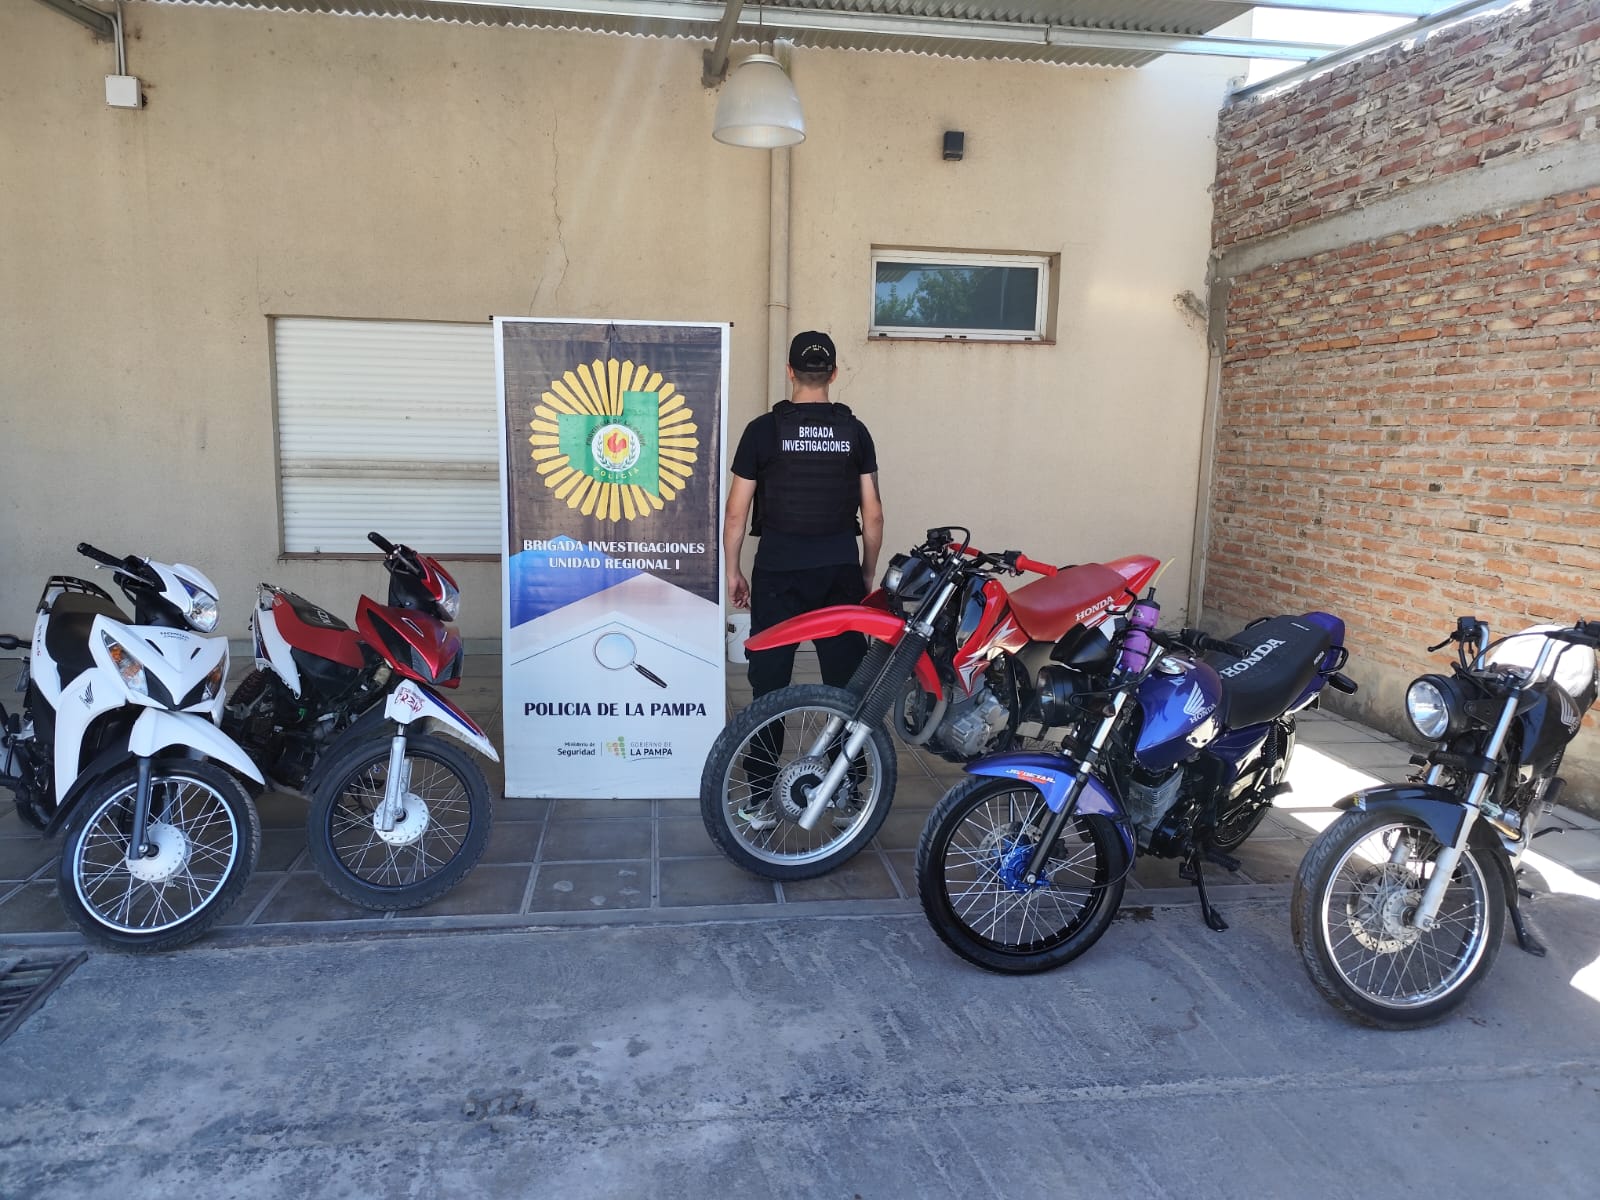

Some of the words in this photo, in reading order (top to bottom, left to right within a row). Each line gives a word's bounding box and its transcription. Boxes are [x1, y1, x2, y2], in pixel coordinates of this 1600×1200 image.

[799, 426, 834, 438] BRIGADA
[782, 440, 850, 452] INVESTIGACIONES
[523, 539, 583, 552] BRIGADA
[588, 540, 705, 554] INVESTIGACIONES
[549, 557, 601, 569] UNIDAD
[605, 558, 672, 570] REGIONAL
[675, 559, 680, 570] I
[1074, 595, 1115, 622] HONDA
[1219, 638, 1287, 679] HONDA
[524, 702, 592, 716] POLICIA
[597, 703, 620, 716] DE
[625, 703, 645, 716] LA
[650, 703, 707, 716] PAMPA
[1189, 703, 1217, 724] HONDA
[557, 748, 596, 757] Seguridad
[630, 748, 642, 756] LA
[643, 748, 673, 756] PAMPA
